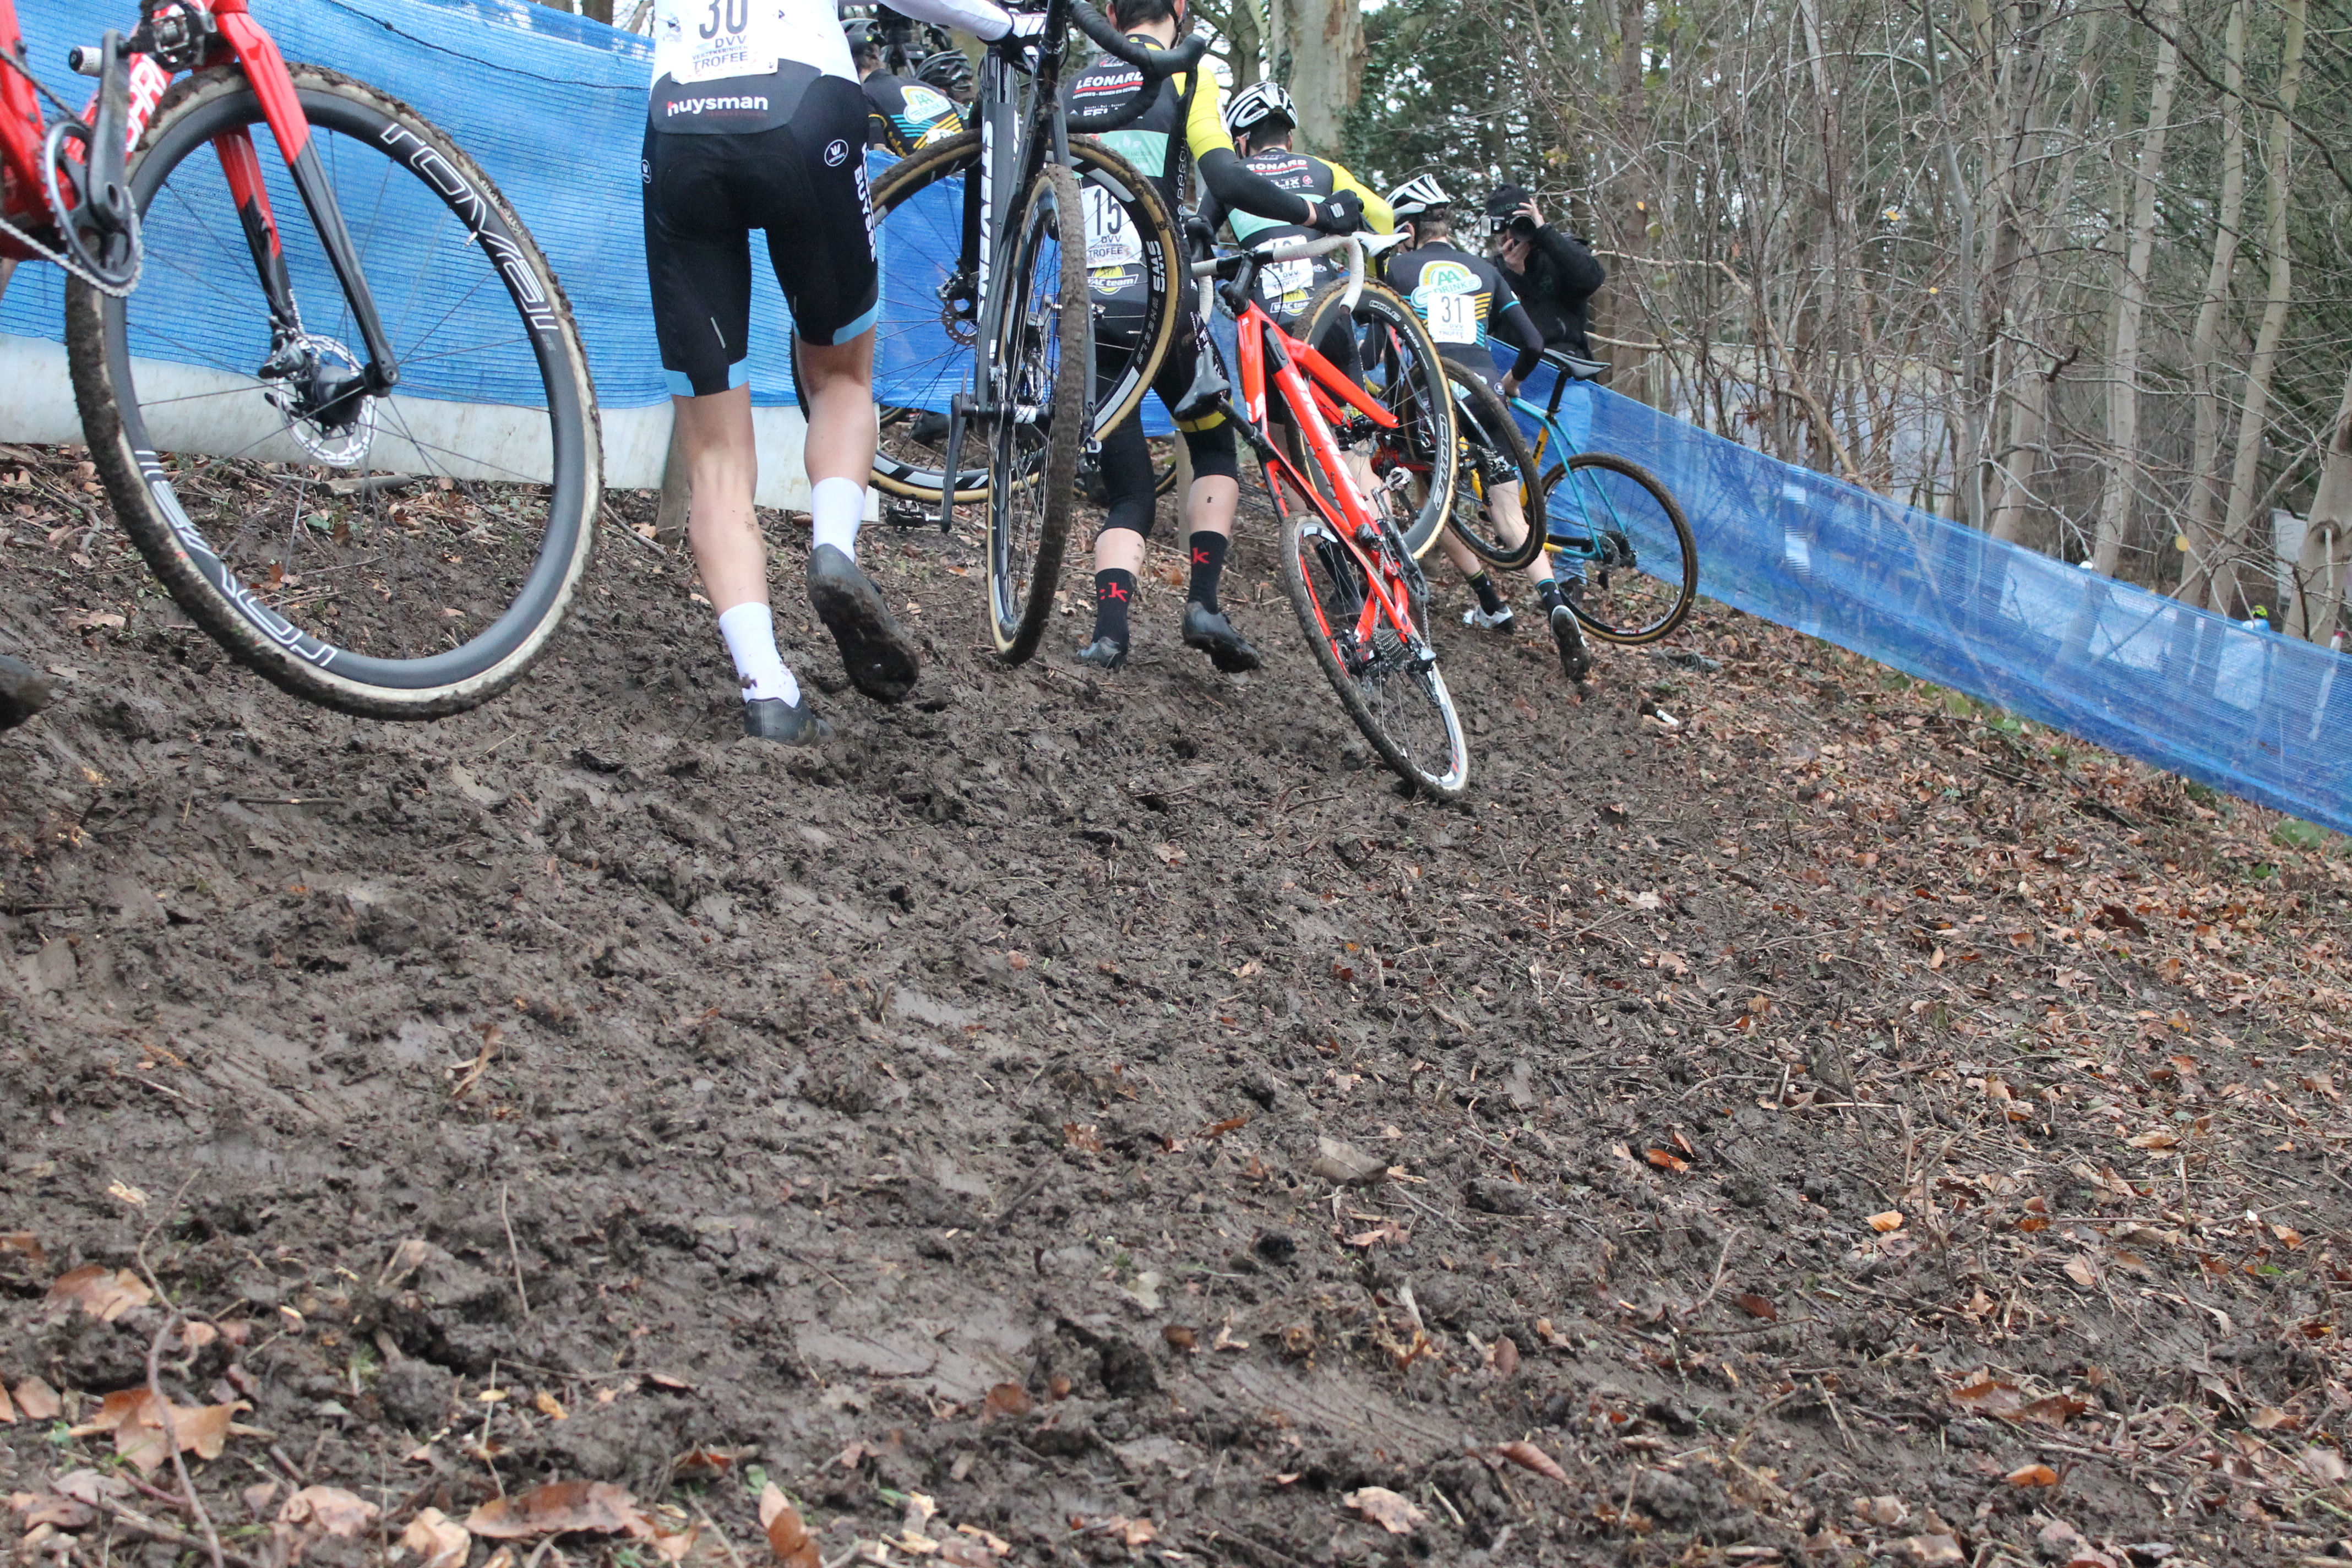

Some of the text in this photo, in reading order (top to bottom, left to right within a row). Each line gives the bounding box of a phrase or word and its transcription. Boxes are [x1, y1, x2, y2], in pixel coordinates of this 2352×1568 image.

[699, 0, 748, 40] 30
[715, 35, 747, 48] DVV
[692, 46, 748, 60] VERZEKERINGEN
[693, 51, 748, 70] TROFEE
[667, 96, 769, 117] huysman
[1245, 159, 1308, 171] EONARD
[1275, 178, 1300, 187] LIX
[854, 165, 877, 262] BUYSSE
[1094, 188, 1122, 236] 15
[1101, 235, 1122, 243] DVV
[1088, 247, 1123, 258] TROFEE
[1106, 277, 1134, 286] team
[1438, 270, 1461, 286] AA
[1434, 281, 1468, 293] DRINK
[1441, 296, 1461, 324] 31
